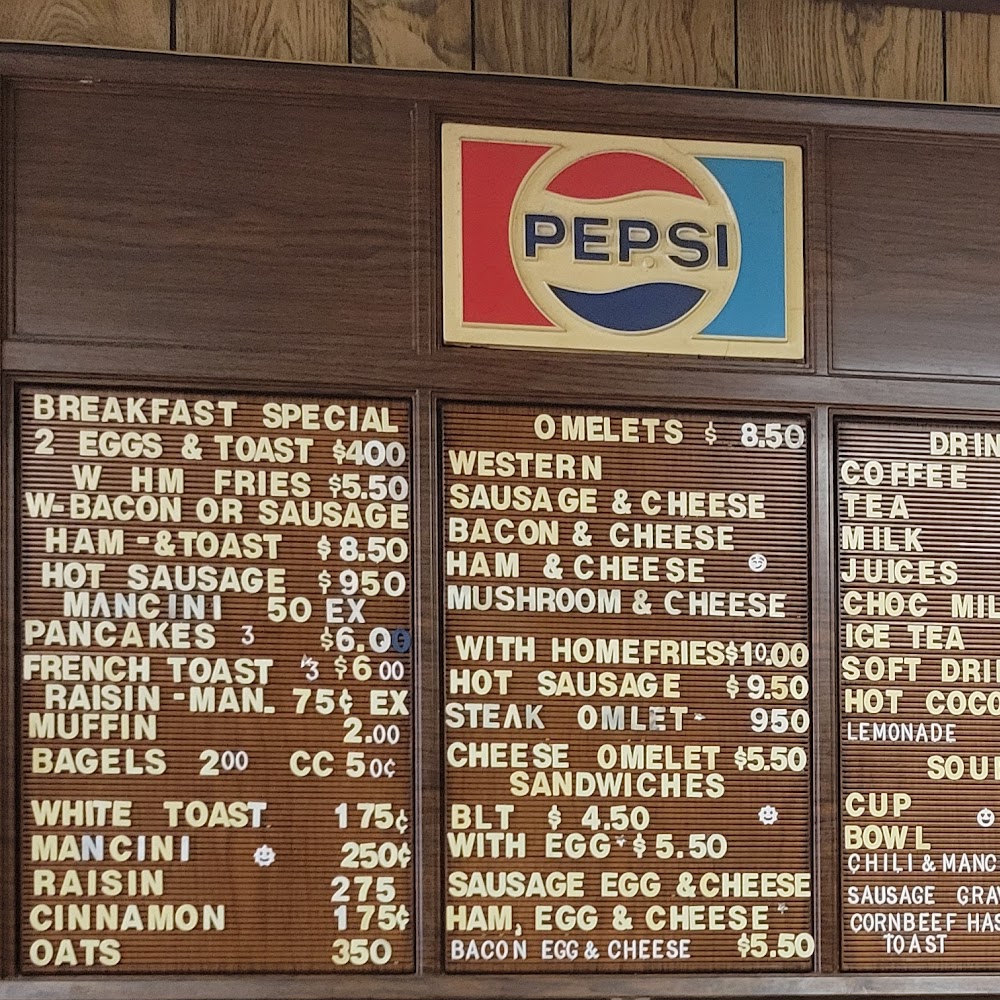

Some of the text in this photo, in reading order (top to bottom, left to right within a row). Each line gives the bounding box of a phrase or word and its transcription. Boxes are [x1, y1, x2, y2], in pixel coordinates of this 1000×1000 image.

[525, 214, 729, 268] PEPSI
[34, 394, 399, 433] BREAKFAST SPECIAL
[534, 414, 683, 444] OMELETS
[79, 431, 162, 458] EGGS
[214, 436, 313, 463] TOAST
[449, 450, 602, 480] WESTERN
[841, 460, 967, 488] COFFEE
[214, 470, 311, 497] FRIES
[196, 498, 409, 529] OR SAUSAGE
[641, 490, 765, 519] CHEESE
[843, 494, 909, 519] TEA
[45, 528, 124, 555] HAM
[449, 517, 734, 551] BACON CHEESE
[842, 526, 923, 552] MILK
[42, 562, 286, 593] HOT SAUSAGE
[447, 551, 519, 578] HAM
[842, 558, 958, 585] JUICES
[63, 592, 365, 623] MANCINI EX
[447, 585, 621, 614] MUSHROOM
[843, 591, 927, 617] CHOC
[25, 620, 216, 649] PANCAKES
[846, 624, 965, 650] ICE TEA
[455, 636, 535, 662] WITH
[23, 655, 273, 685] FRENCH TOAST
[449, 669, 512, 695] HOT
[842, 656, 922, 681] SOFT
[45, 685, 160, 712] RAISIN
[29, 713, 157, 740] MUFFIN
[445, 703, 544, 730] STEAK
[847, 722, 957, 742] LEMONADE
[32, 748, 166, 775] BAGELS
[597, 744, 720, 771] OMELET
[510, 772, 725, 798] SANDWICHES
[31, 800, 132, 826] WHITE
[451, 805, 514, 830] BLT
[845, 792, 912, 817] CUP
[31, 835, 190, 862] MANCINI
[447, 833, 611, 858] WITH EGG
[844, 825, 931, 850] BOWL
[848, 853, 913, 875] CHILI
[33, 869, 164, 897] RAISIN
[601, 872, 661, 898] EGG
[29, 904, 225, 932] CINNAMON
[850, 913, 957, 933] CORNBEEF
[29, 939, 392, 966] OATS 350
[450, 933, 815, 961] BACON $5.50
